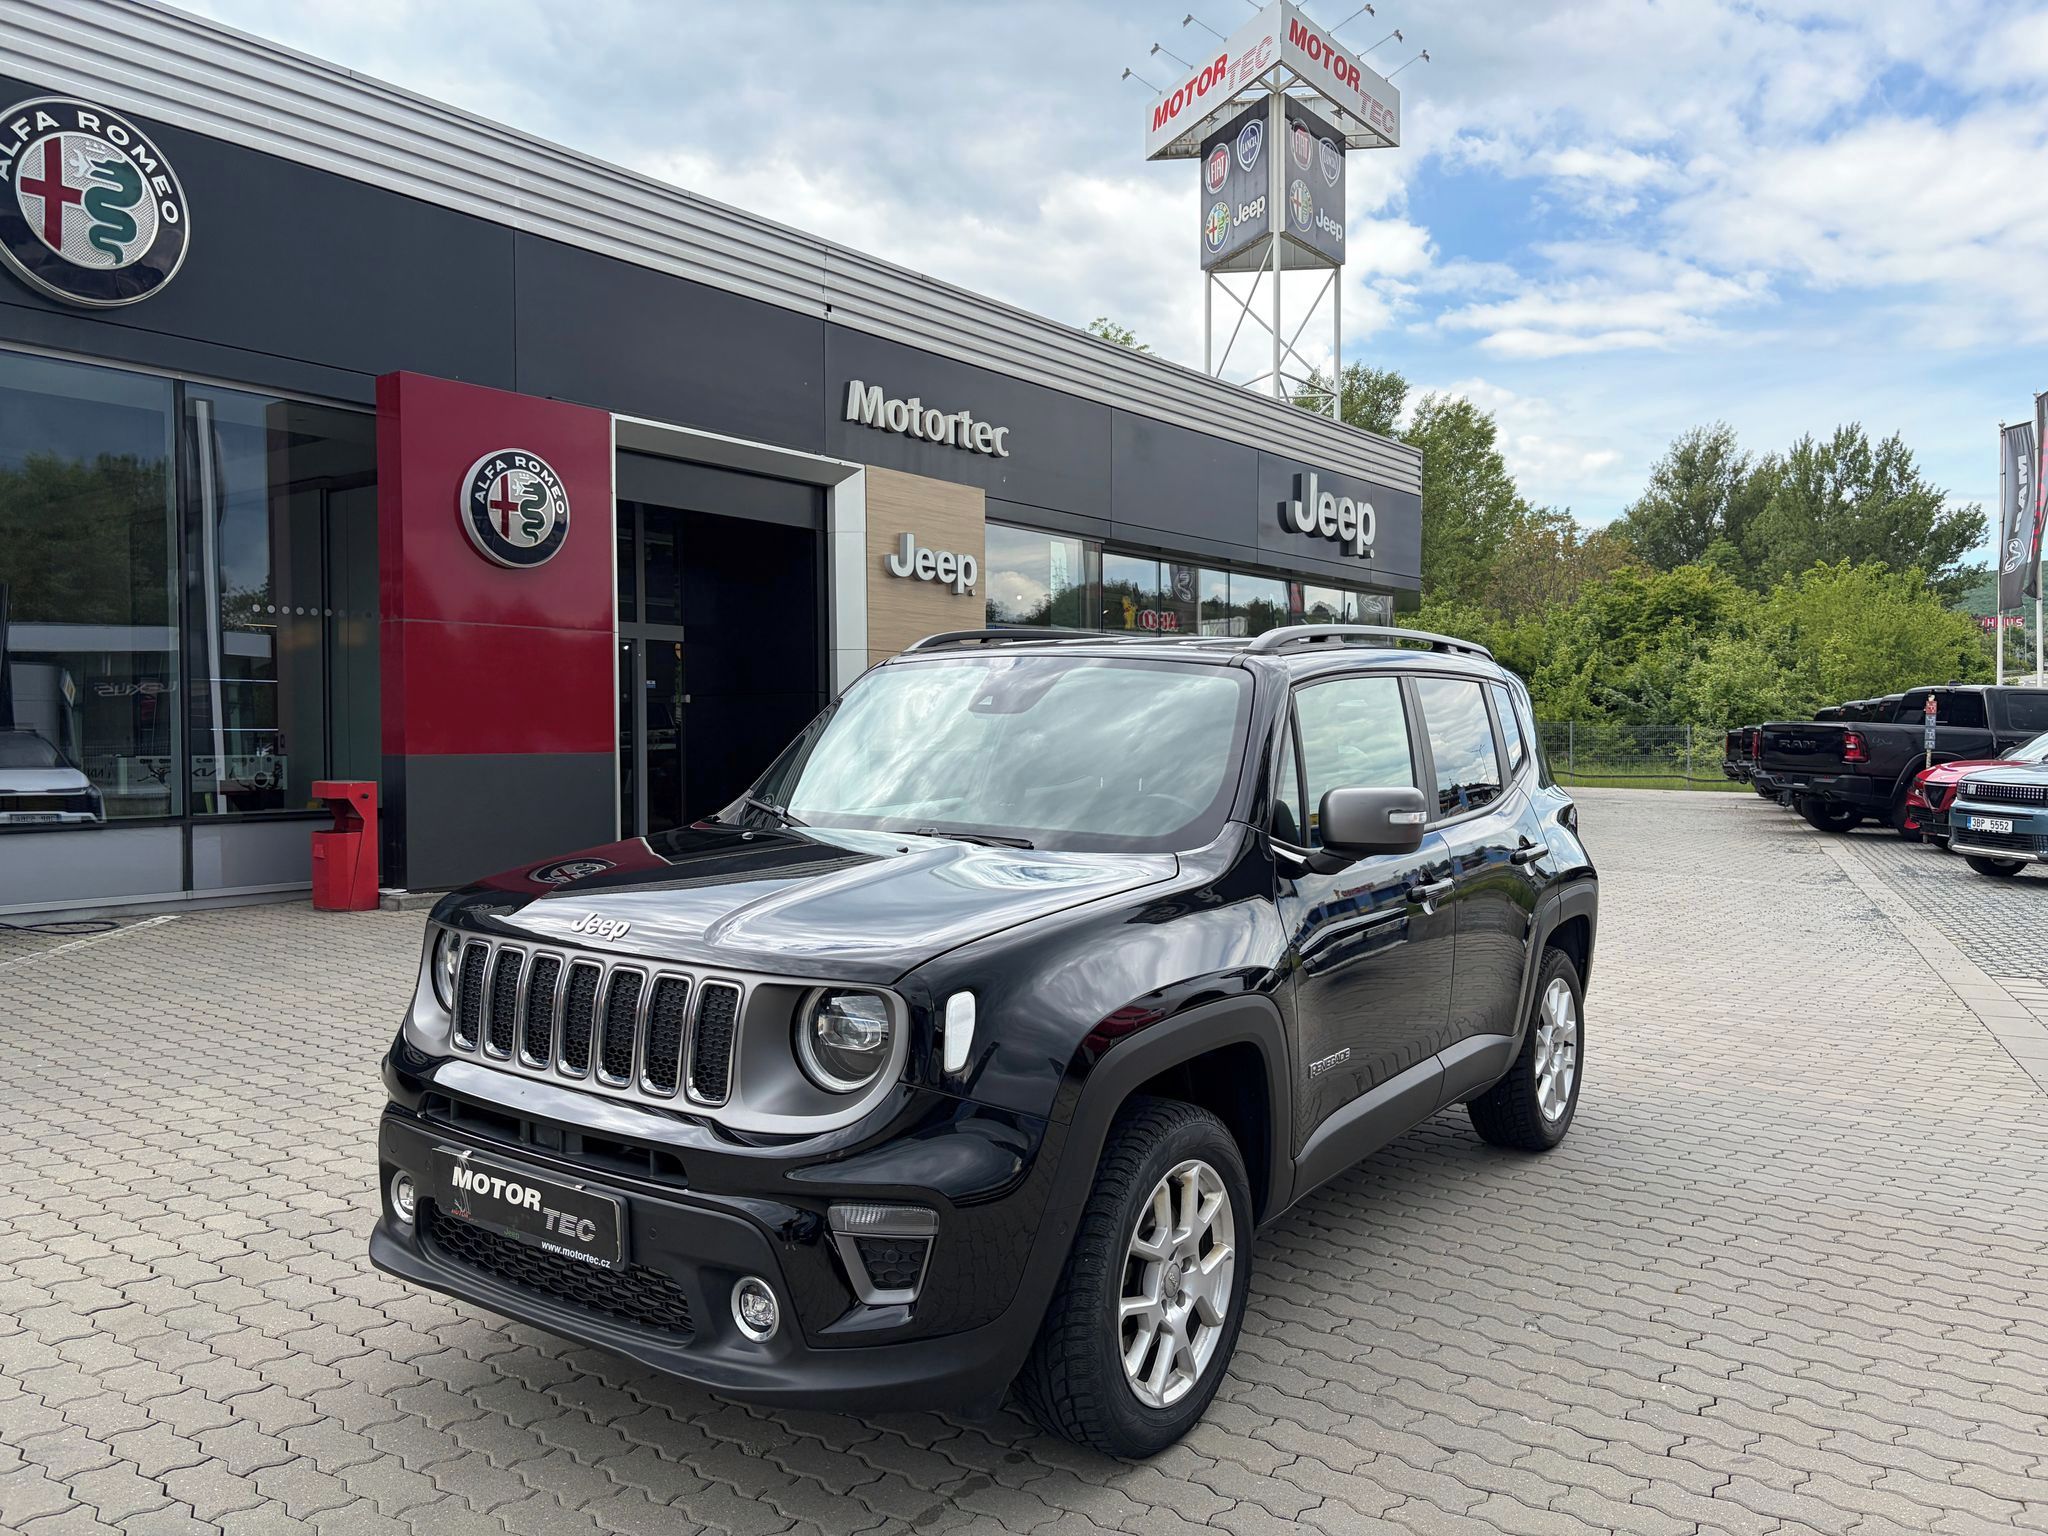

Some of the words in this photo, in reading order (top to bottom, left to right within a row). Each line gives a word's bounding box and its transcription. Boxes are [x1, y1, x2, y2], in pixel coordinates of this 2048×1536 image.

[0, 111, 60, 182] ALFA
[77, 110, 179, 224] ROMEO
[1210, 154, 1225, 184] FIAT
[1233, 195, 1266, 227] Jeep
[1315, 207, 1343, 242] Jeep
[847, 379, 1009, 457] Motortec
[474, 459, 508, 504] ALFA
[514, 456, 565, 514] ROMEO
[1288, 471, 1376, 557] Jeep
[885, 532, 977, 596] Jeep
[1778, 739, 1817, 749] RAM
[1972, 818, 1985, 828] 3BP
[1990, 820, 2009, 831] 5552
[570, 912, 631, 942] Jeep
[1309, 1047, 1350, 1078] RENEGADE
[452, 1166, 542, 1212] MOTOR
[543, 1207, 596, 1242] TEC
[541, 1240, 611, 1269] www.motortec.cz
